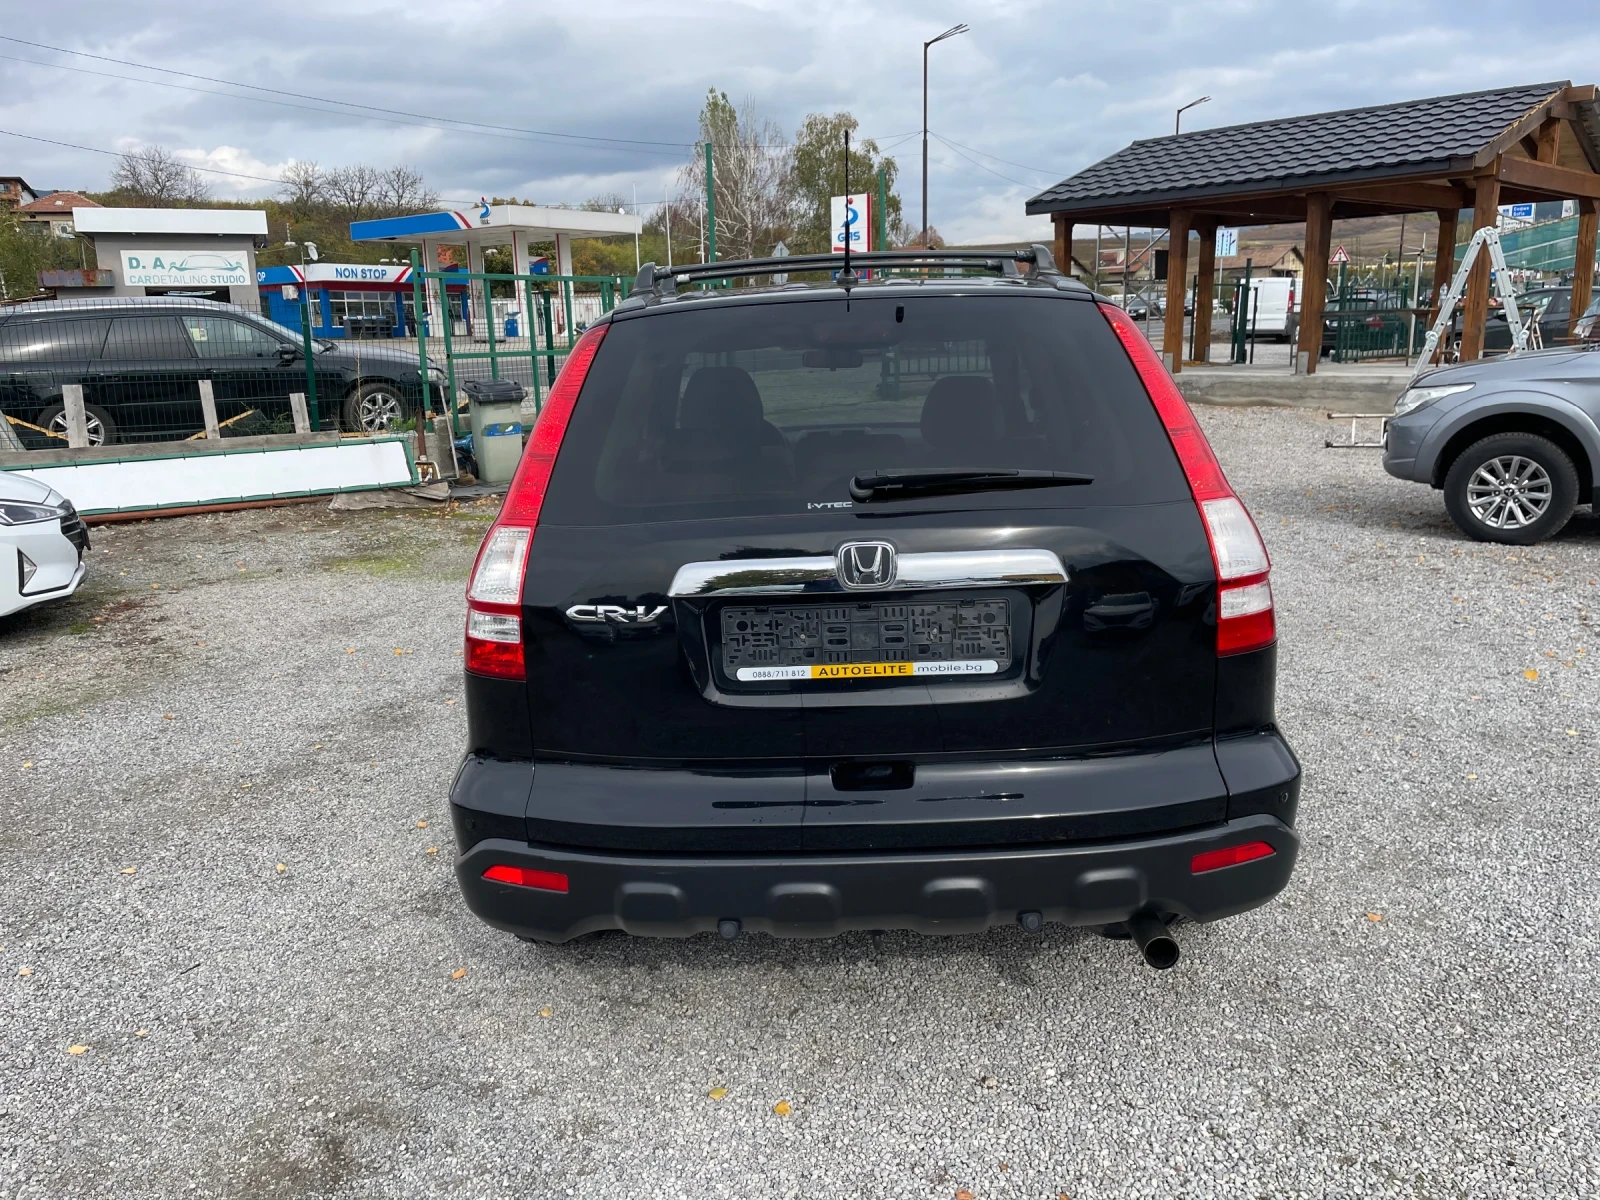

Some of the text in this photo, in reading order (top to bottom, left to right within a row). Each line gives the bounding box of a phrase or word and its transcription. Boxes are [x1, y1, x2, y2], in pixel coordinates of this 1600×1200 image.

[128, 257, 166, 269] D. A
[210, 274, 246, 284] STUDIO
[257, 271, 267, 283] OP
[335, 267, 387, 280] NON STOP
[565, 604, 669, 623] CR-V
[791, 669, 806, 677] 812
[818, 664, 908, 677] AUTOELITE
